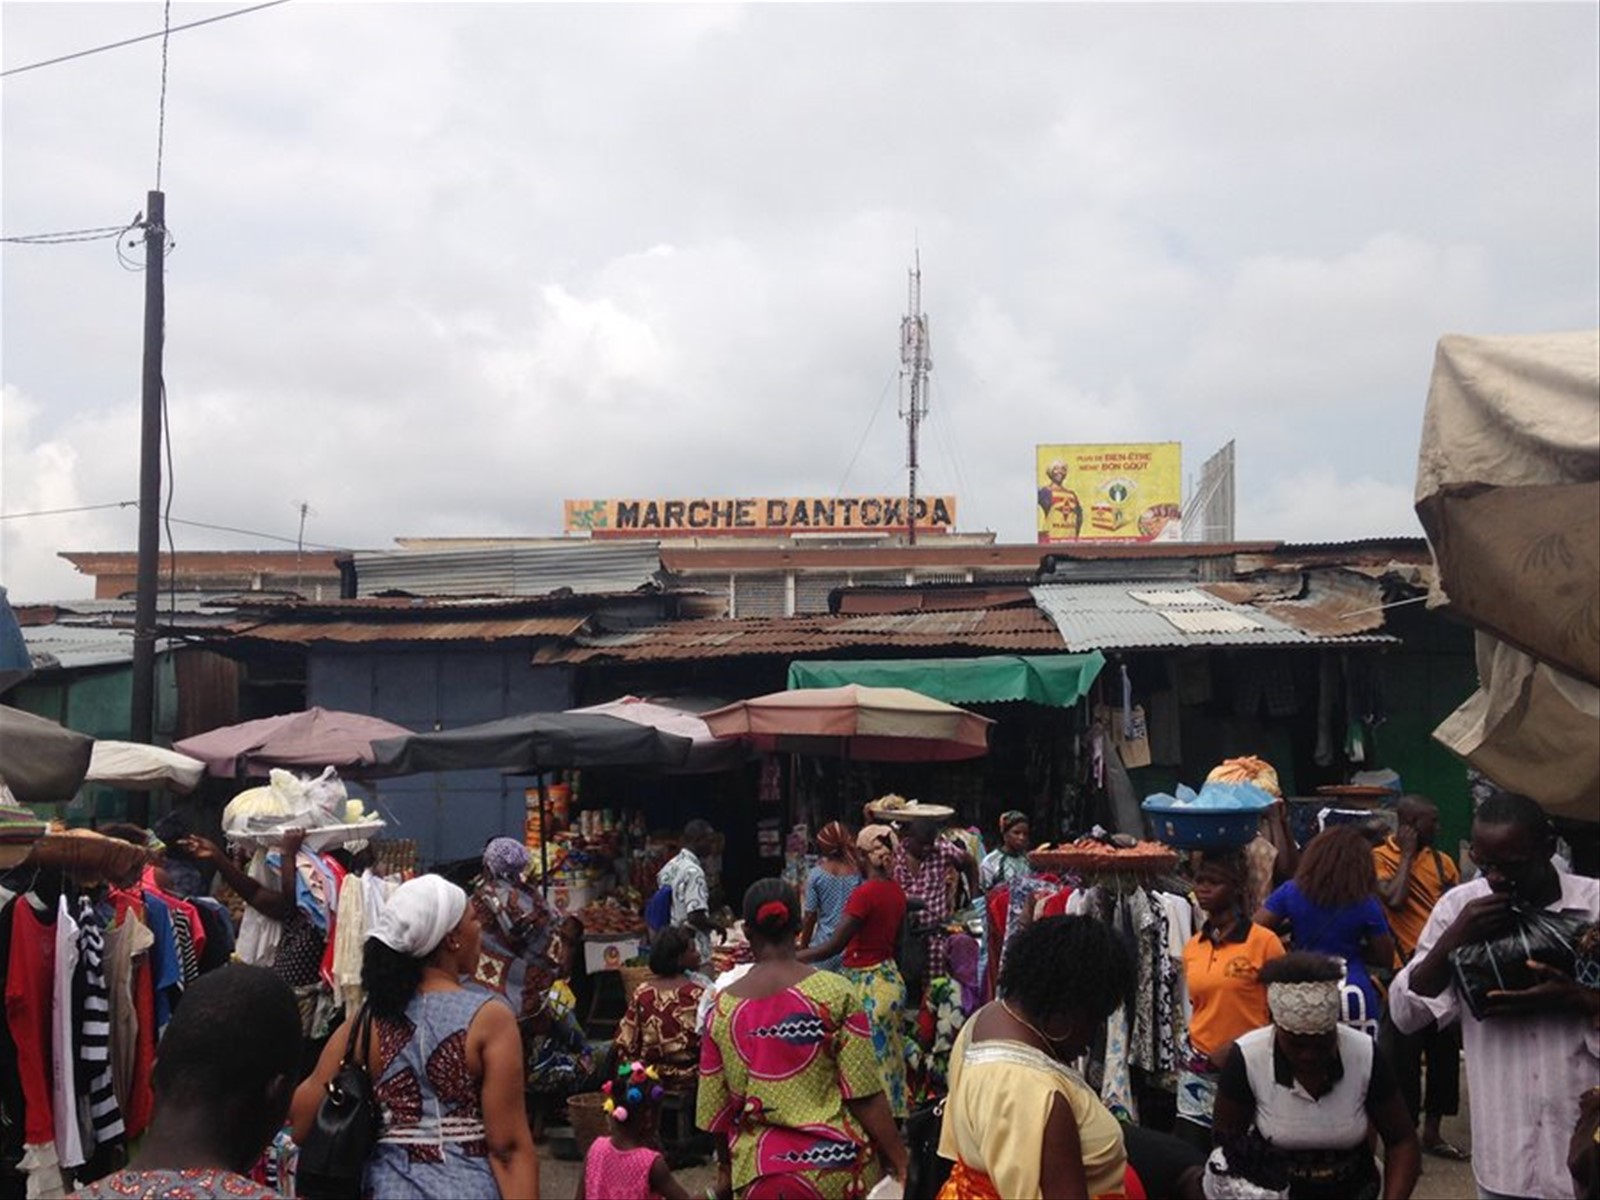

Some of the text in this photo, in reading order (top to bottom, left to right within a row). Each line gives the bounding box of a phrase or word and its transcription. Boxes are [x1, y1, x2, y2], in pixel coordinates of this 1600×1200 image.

[1101, 462, 1121, 471] BON
[616, 499, 952, 528] MARCHE DANTOKPA
